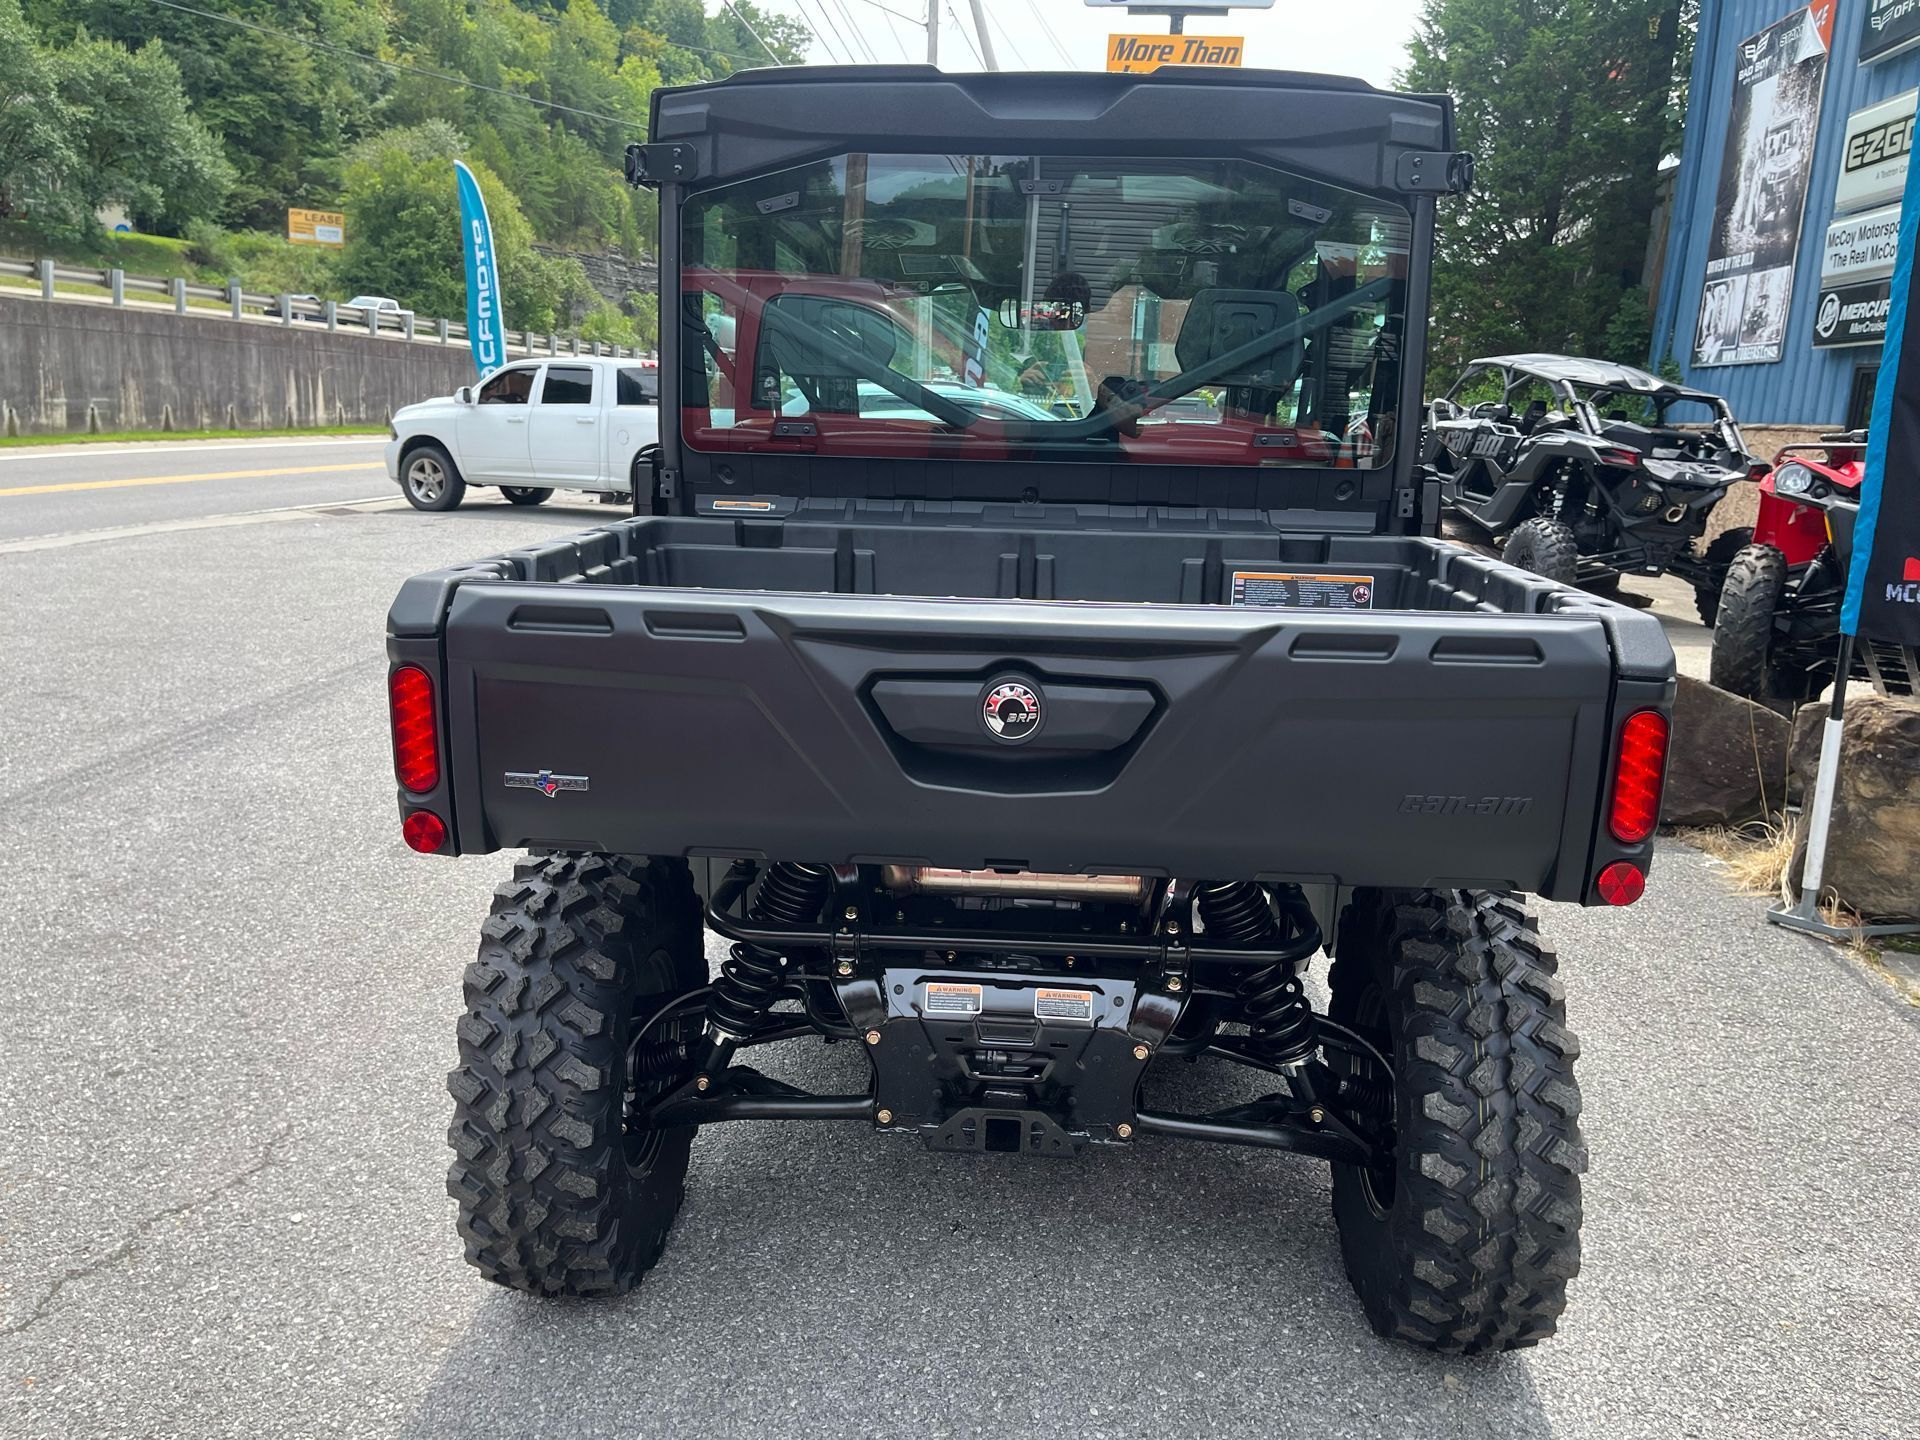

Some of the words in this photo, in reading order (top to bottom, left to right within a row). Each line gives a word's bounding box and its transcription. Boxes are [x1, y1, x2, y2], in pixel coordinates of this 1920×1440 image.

[1112, 38, 1175, 62] More
[1181, 40, 1239, 64] Than
[1738, 65, 1754, 81] BAD
[1754, 55, 1772, 73] BOY
[304, 213, 342, 225] LEASE
[1827, 230, 1857, 248] McCoy
[1849, 249, 1869, 266] Real
[1870, 242, 1897, 262] McCo
[472, 219, 496, 364] CFMOTO
[1006, 712, 1038, 723] BRP
[1398, 794, 1533, 816] can-am
